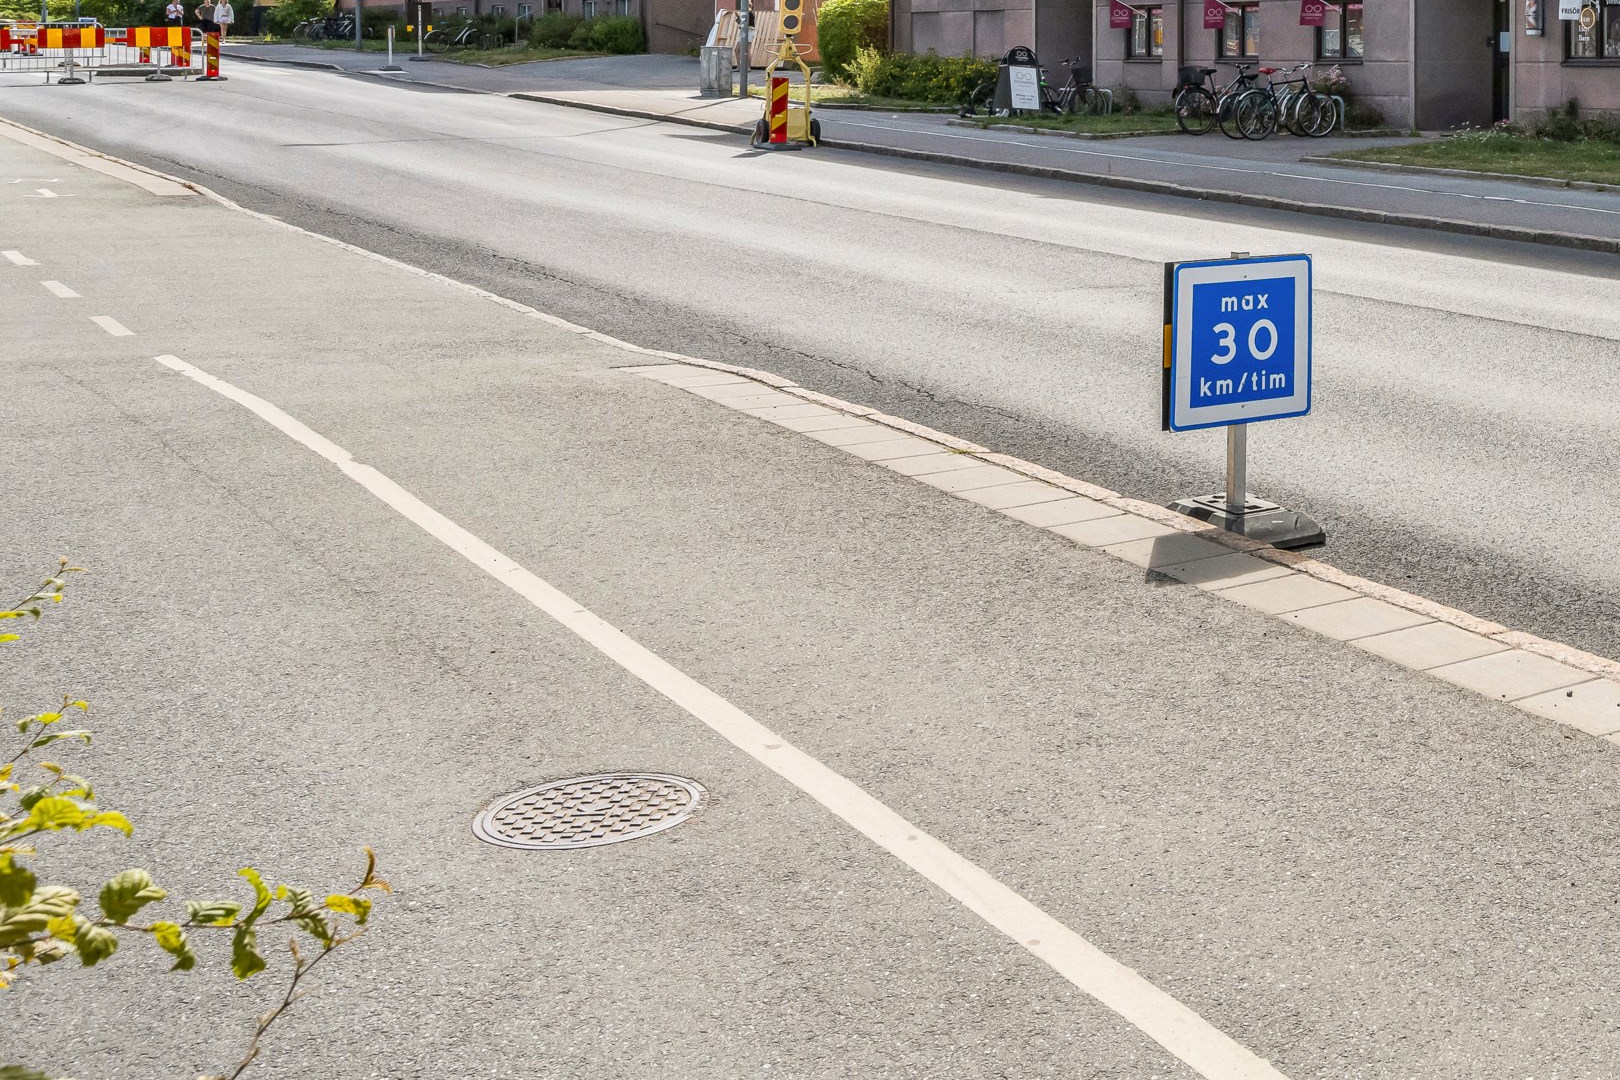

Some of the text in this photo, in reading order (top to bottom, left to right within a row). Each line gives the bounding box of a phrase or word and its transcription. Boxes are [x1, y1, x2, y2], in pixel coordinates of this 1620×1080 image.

[1561, 7, 1581, 15] FRISÖR
[1221, 293, 1269, 313] max
[1210, 318, 1279, 365] 30
[1200, 369, 1286, 398] km/tim
